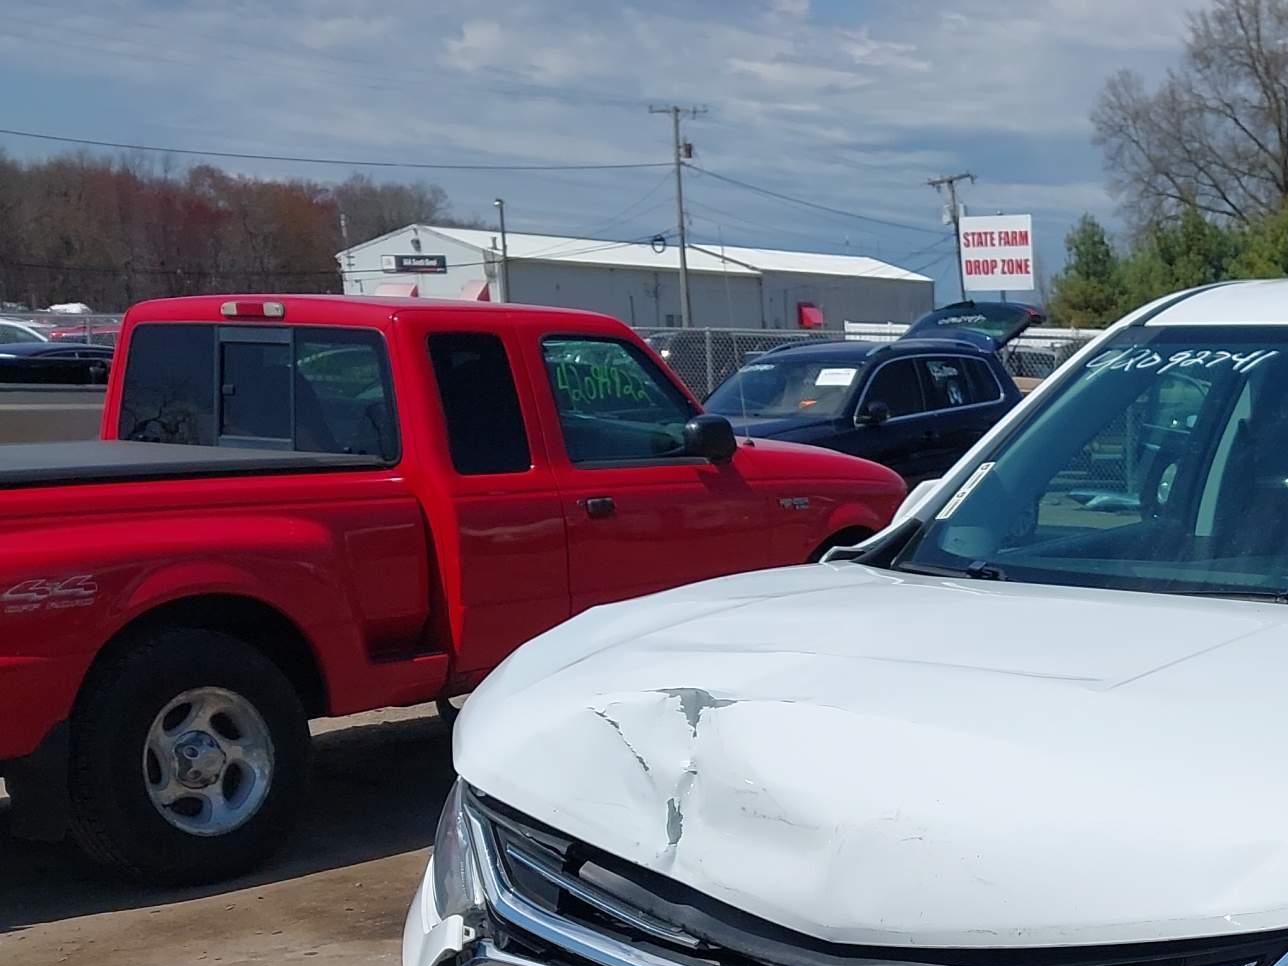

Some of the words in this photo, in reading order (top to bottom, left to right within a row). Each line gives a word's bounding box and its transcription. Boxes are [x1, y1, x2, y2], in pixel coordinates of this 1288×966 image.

[963, 231, 996, 248] STATE
[998, 230, 1030, 247] FARM
[965, 259, 998, 276] DROP
[1000, 258, 1031, 275] ZONE
[1086, 344, 1280, 380] 42092741
